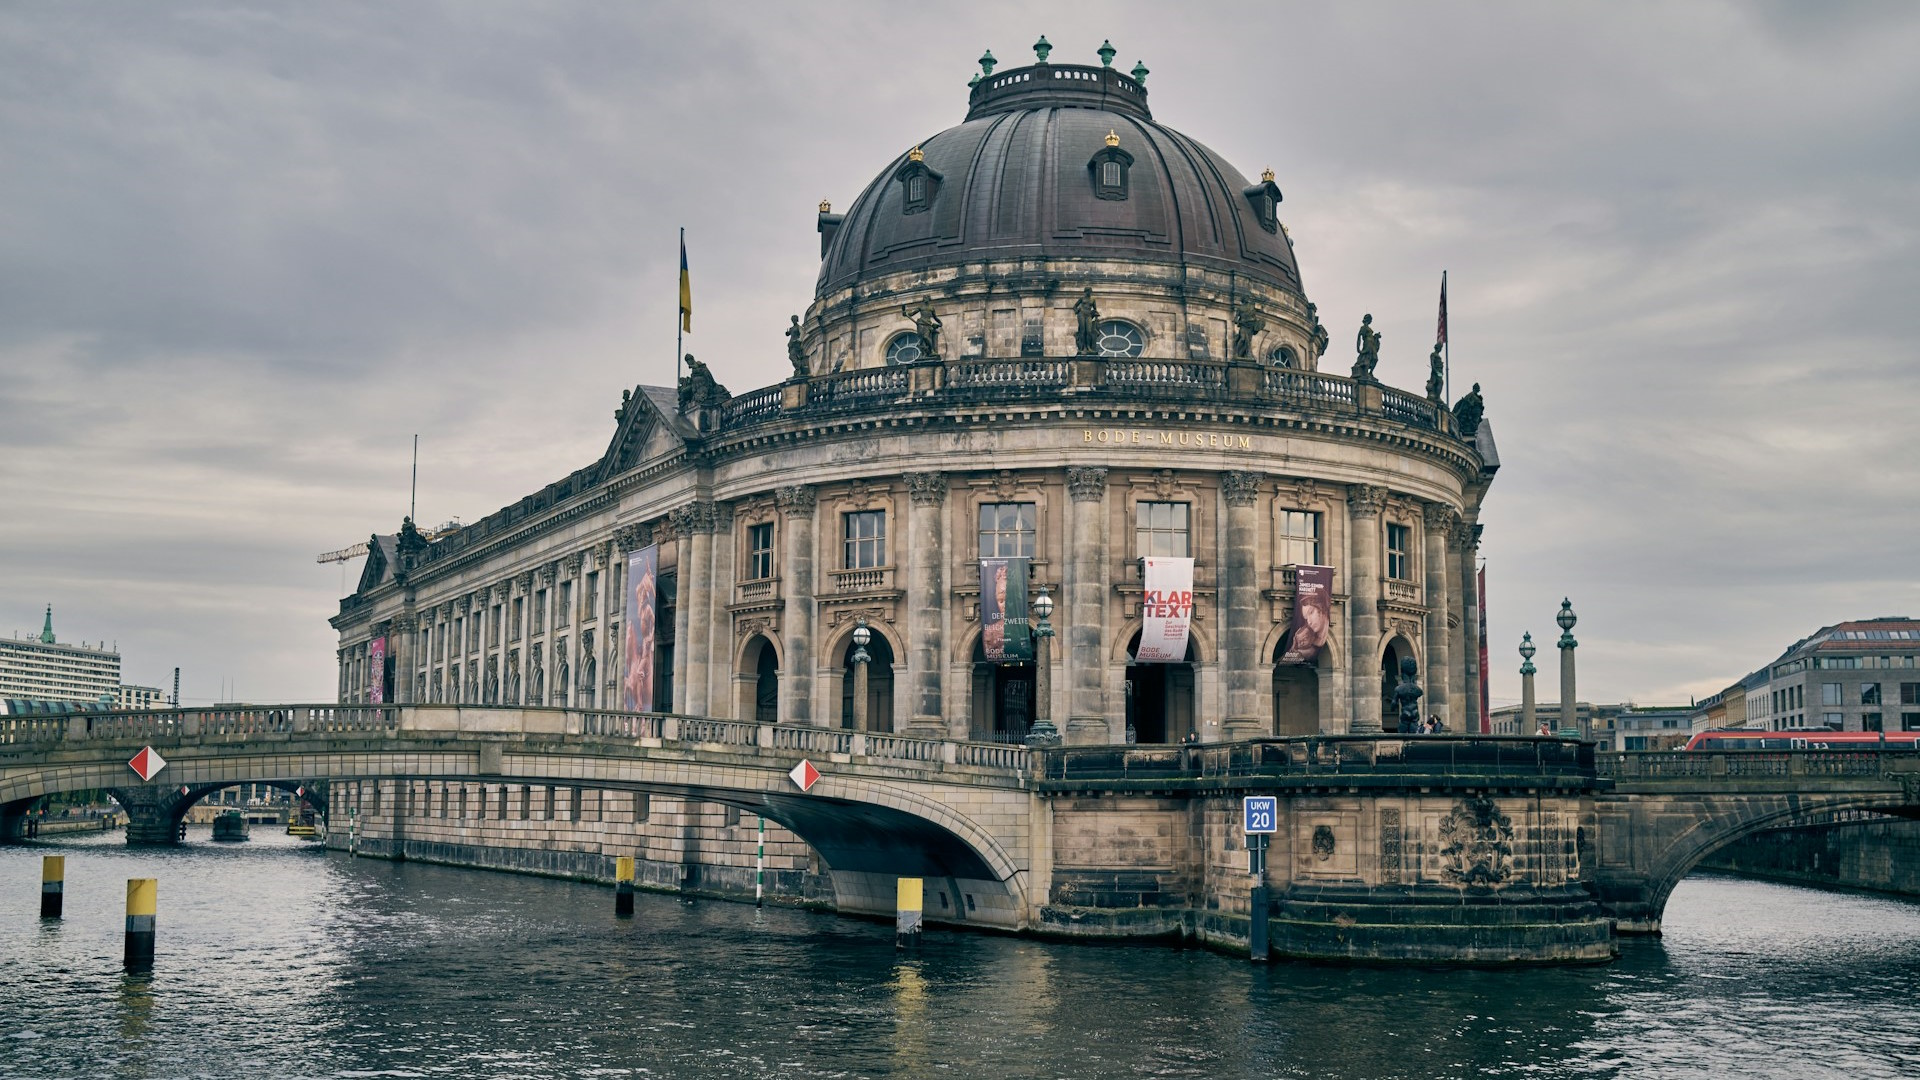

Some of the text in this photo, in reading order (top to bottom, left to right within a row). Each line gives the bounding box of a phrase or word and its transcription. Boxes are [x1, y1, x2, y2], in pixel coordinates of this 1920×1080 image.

[1144, 591, 1192, 604] KLAR
[992, 612, 1004, 620] DER
[1144, 605, 1192, 618] TEXT
[1250, 801, 1270, 810] UKW
[1251, 812, 1270, 828] 20
